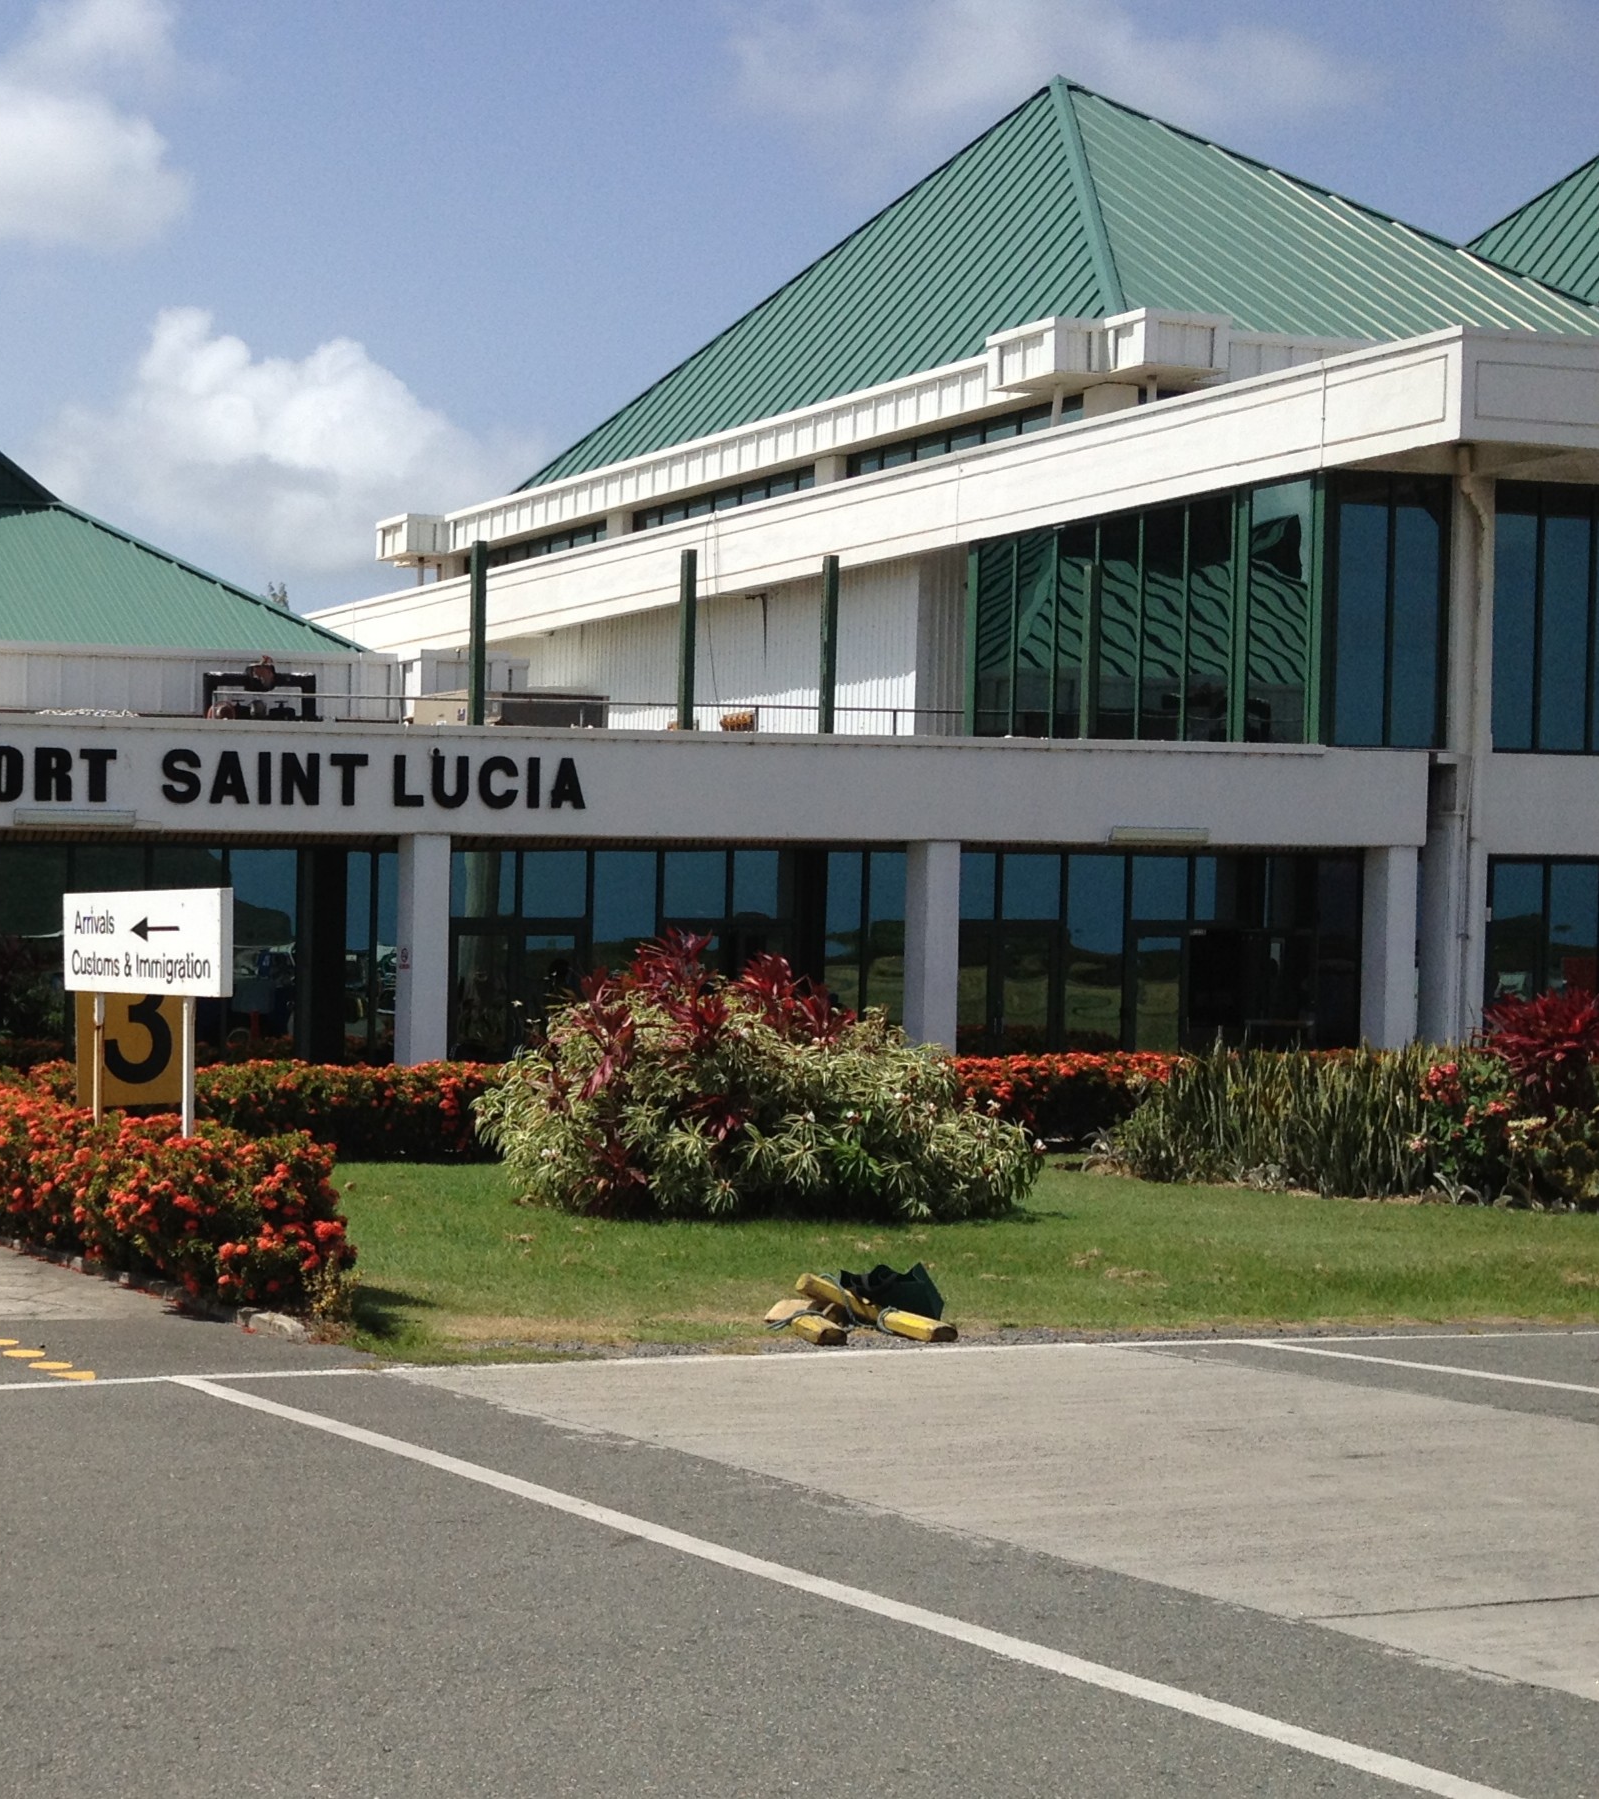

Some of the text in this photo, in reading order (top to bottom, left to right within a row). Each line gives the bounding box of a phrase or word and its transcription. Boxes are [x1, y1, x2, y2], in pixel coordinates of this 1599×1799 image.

[161, 748, 369, 807] SAINT
[392, 754, 587, 810] LUCIA
[74, 909, 115, 935] Arrivals
[71, 949, 211, 984] Customs & Immigration
[104, 994, 173, 1084] 3
